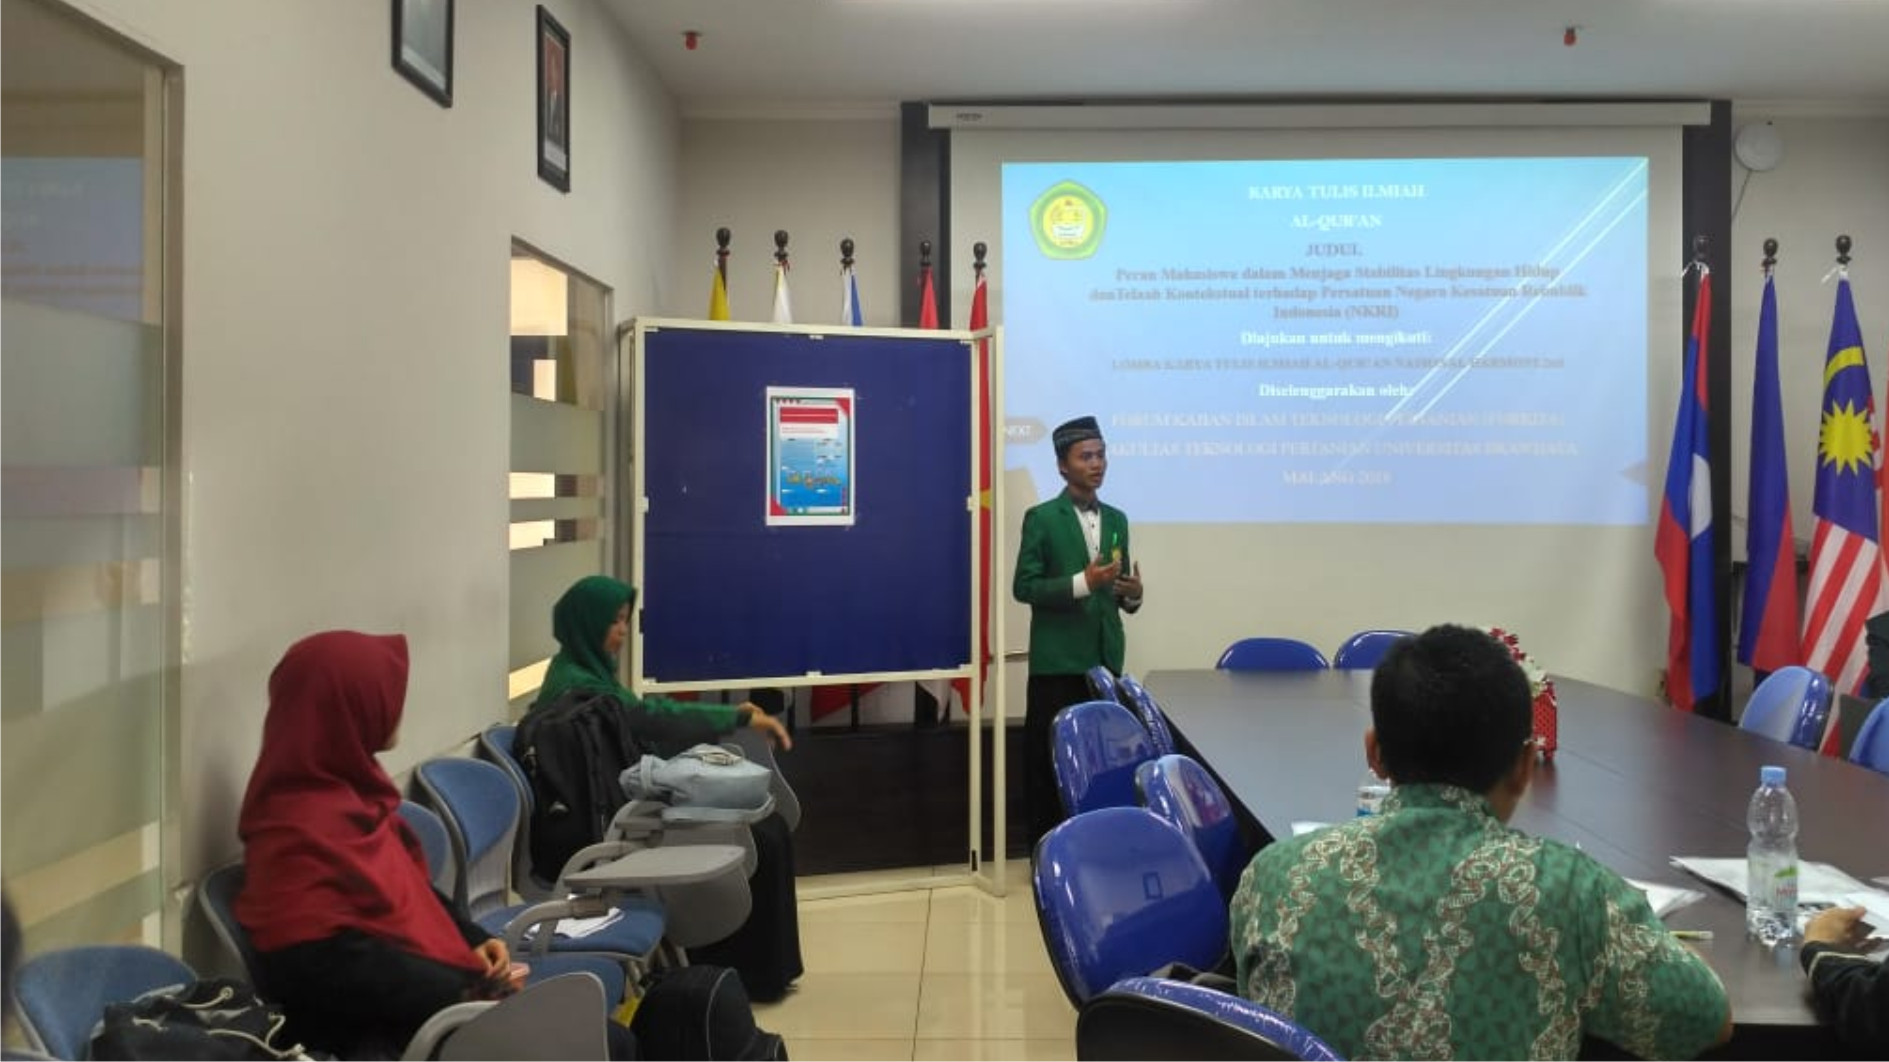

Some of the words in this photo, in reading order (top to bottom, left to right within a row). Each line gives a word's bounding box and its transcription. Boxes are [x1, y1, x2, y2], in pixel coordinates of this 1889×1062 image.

[1248, 185, 1304, 200] KARYA
[1308, 185, 1359, 200] TULIS
[1361, 184, 1426, 199] ILMIAH
[1305, 243, 1363, 257] JUDUL
[1116, 267, 1158, 281] Peran
[1241, 265, 1287, 280] dalam
[1290, 265, 1351, 282] Menjaga
[1354, 263, 1421, 280] Stabilitas
[1424, 263, 1511, 282] Lingkungan
[1515, 262, 1560, 282] Hidup
[1252, 286, 1318, 303] terhadap
[1321, 286, 1392, 300] Persatuan
[1396, 285, 1448, 301] Negara
[1451, 285, 1517, 300] Kesatuan
[1272, 304, 1342, 320] Indonesia
[1345, 304, 1400, 321] (NKRI)
[1241, 331, 1306, 349] Diajukan
[1309, 331, 1353, 346] untuk
[1259, 383, 1376, 400] Diselenggarakan
